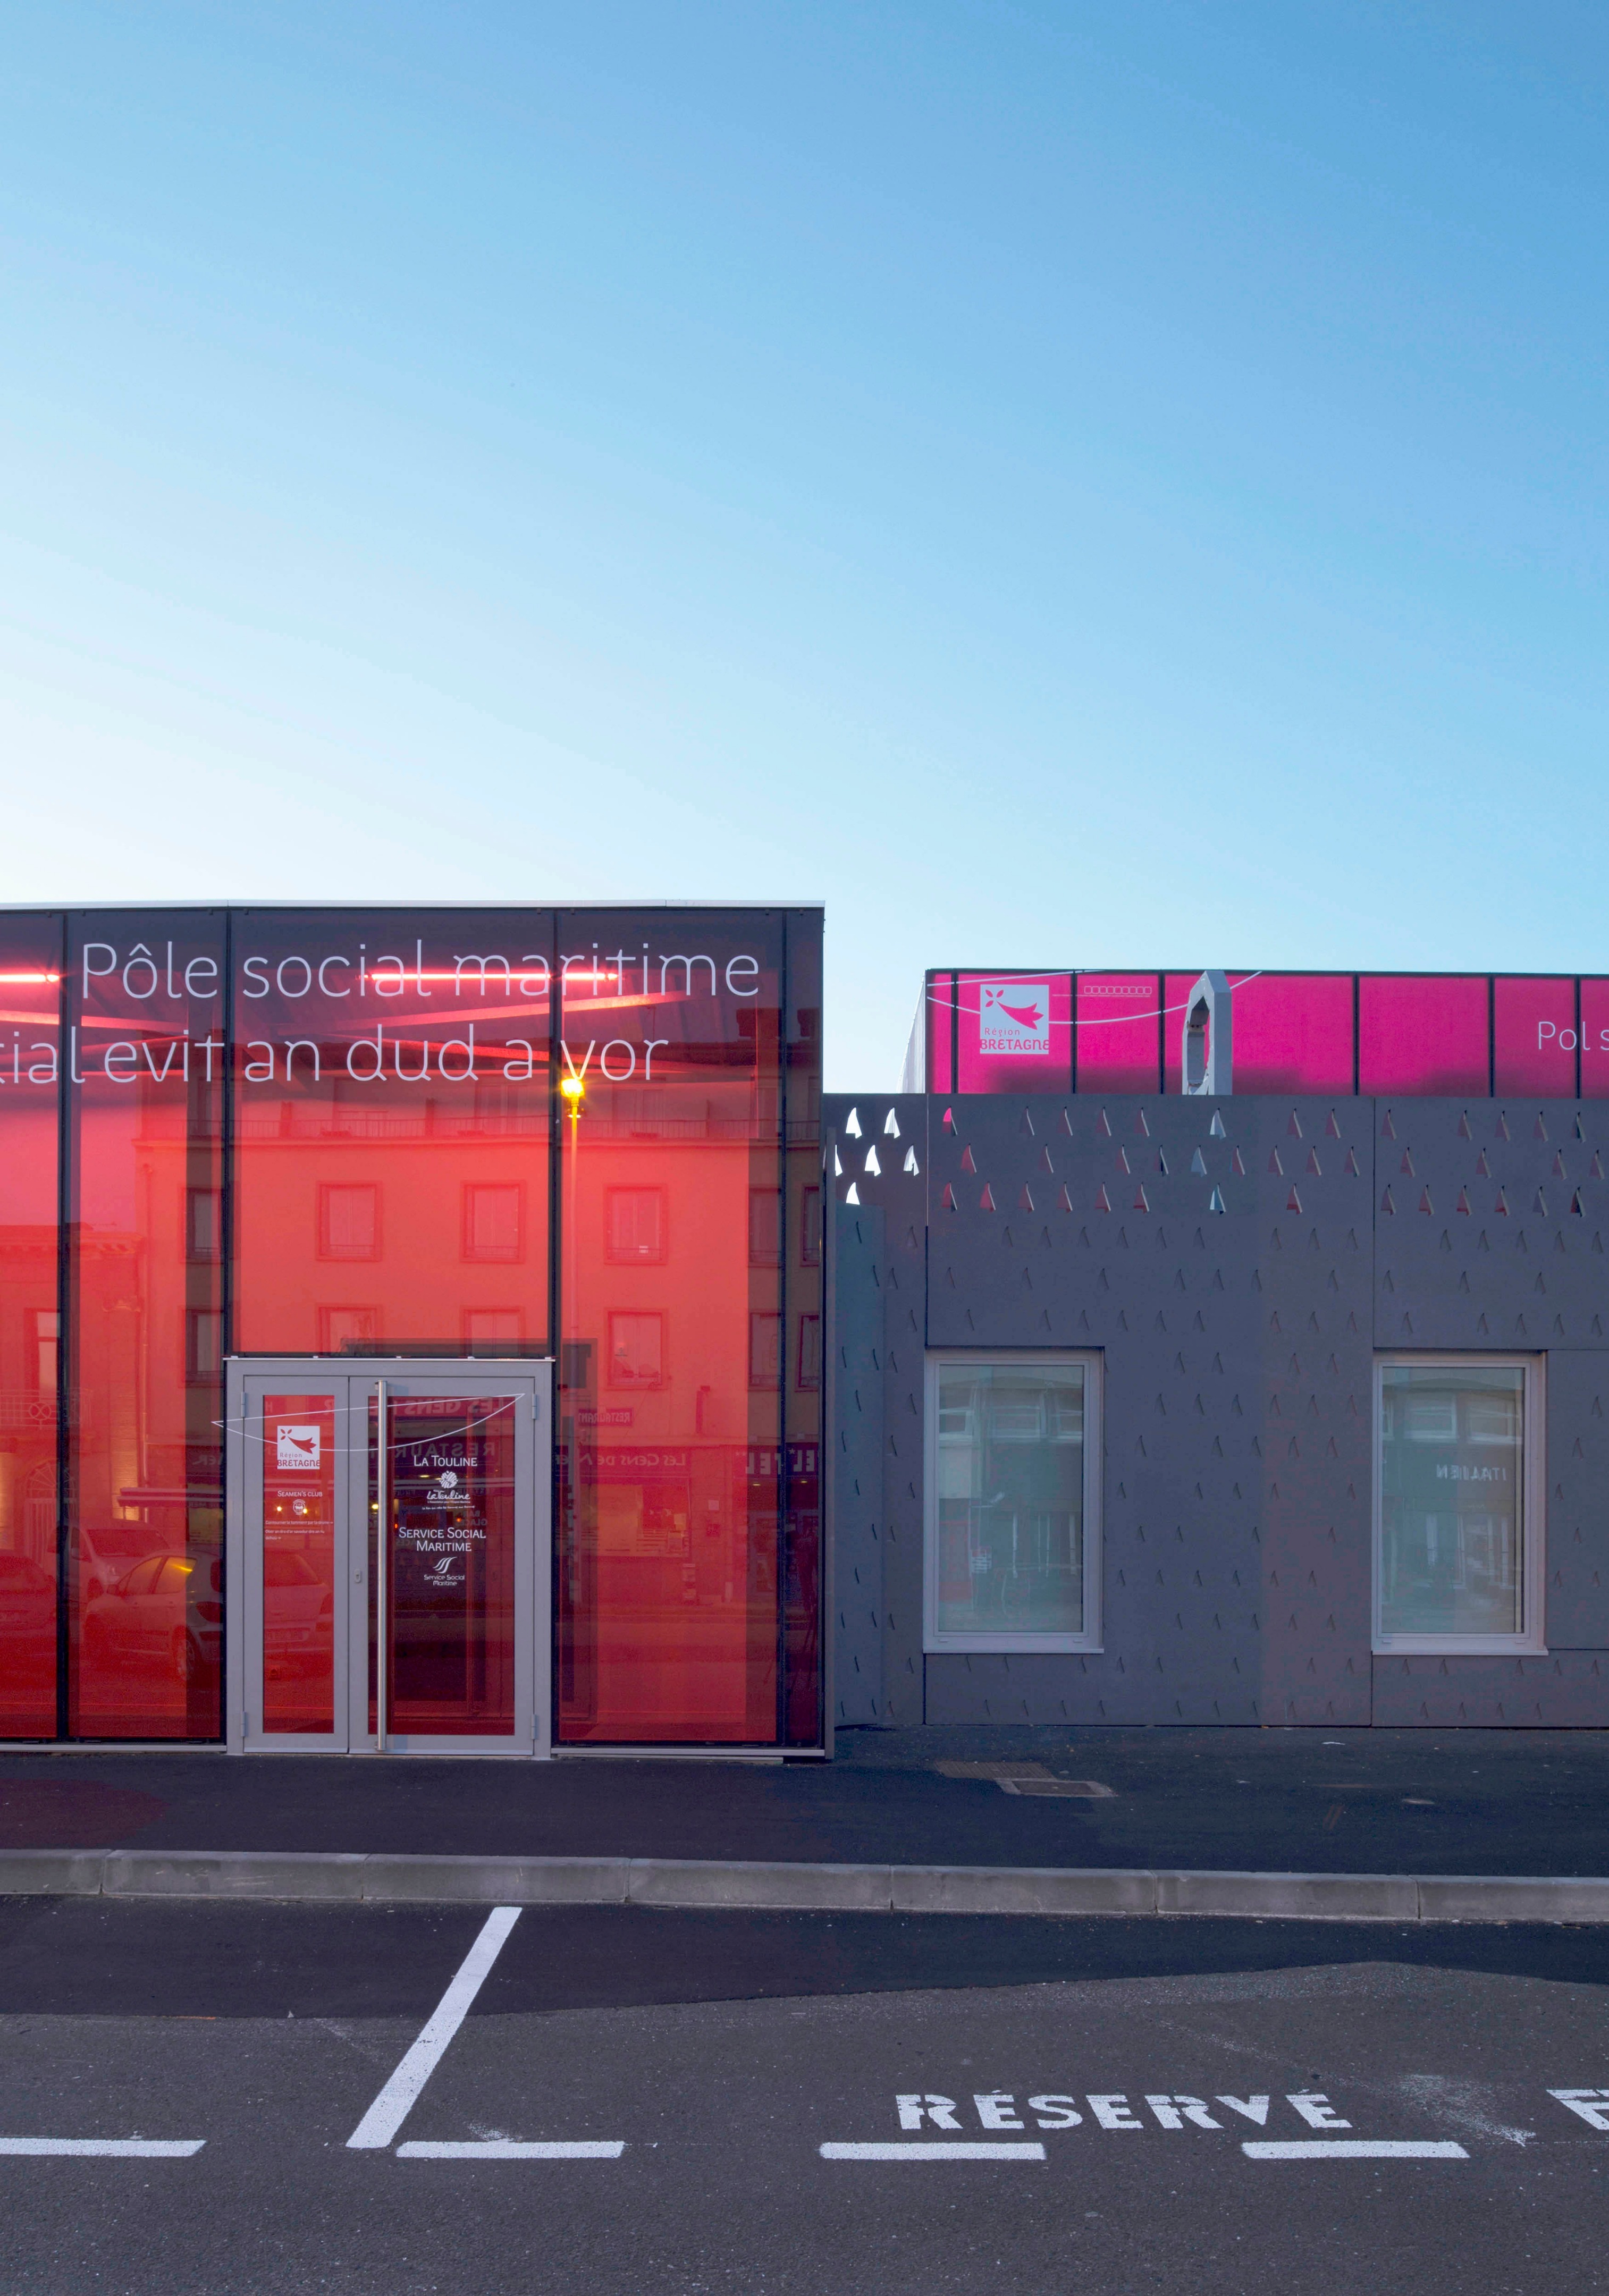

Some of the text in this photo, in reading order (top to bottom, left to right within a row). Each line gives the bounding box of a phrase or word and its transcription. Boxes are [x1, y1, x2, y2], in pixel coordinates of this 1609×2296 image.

[82, 939, 759, 999] Pôle social maritime
[984, 1027, 1020, 1038] Région
[1539, 1021, 1590, 1050] Pol
[980, 1039, 1049, 1051] BRETAGNE
[0, 1024, 669, 1084] ial evit an dud a vor
[414, 1455, 477, 1466] LA TOULINE
[399, 1527, 486, 1539] SERVICE SOCIAL
[417, 1540, 471, 1551] MARITIME
